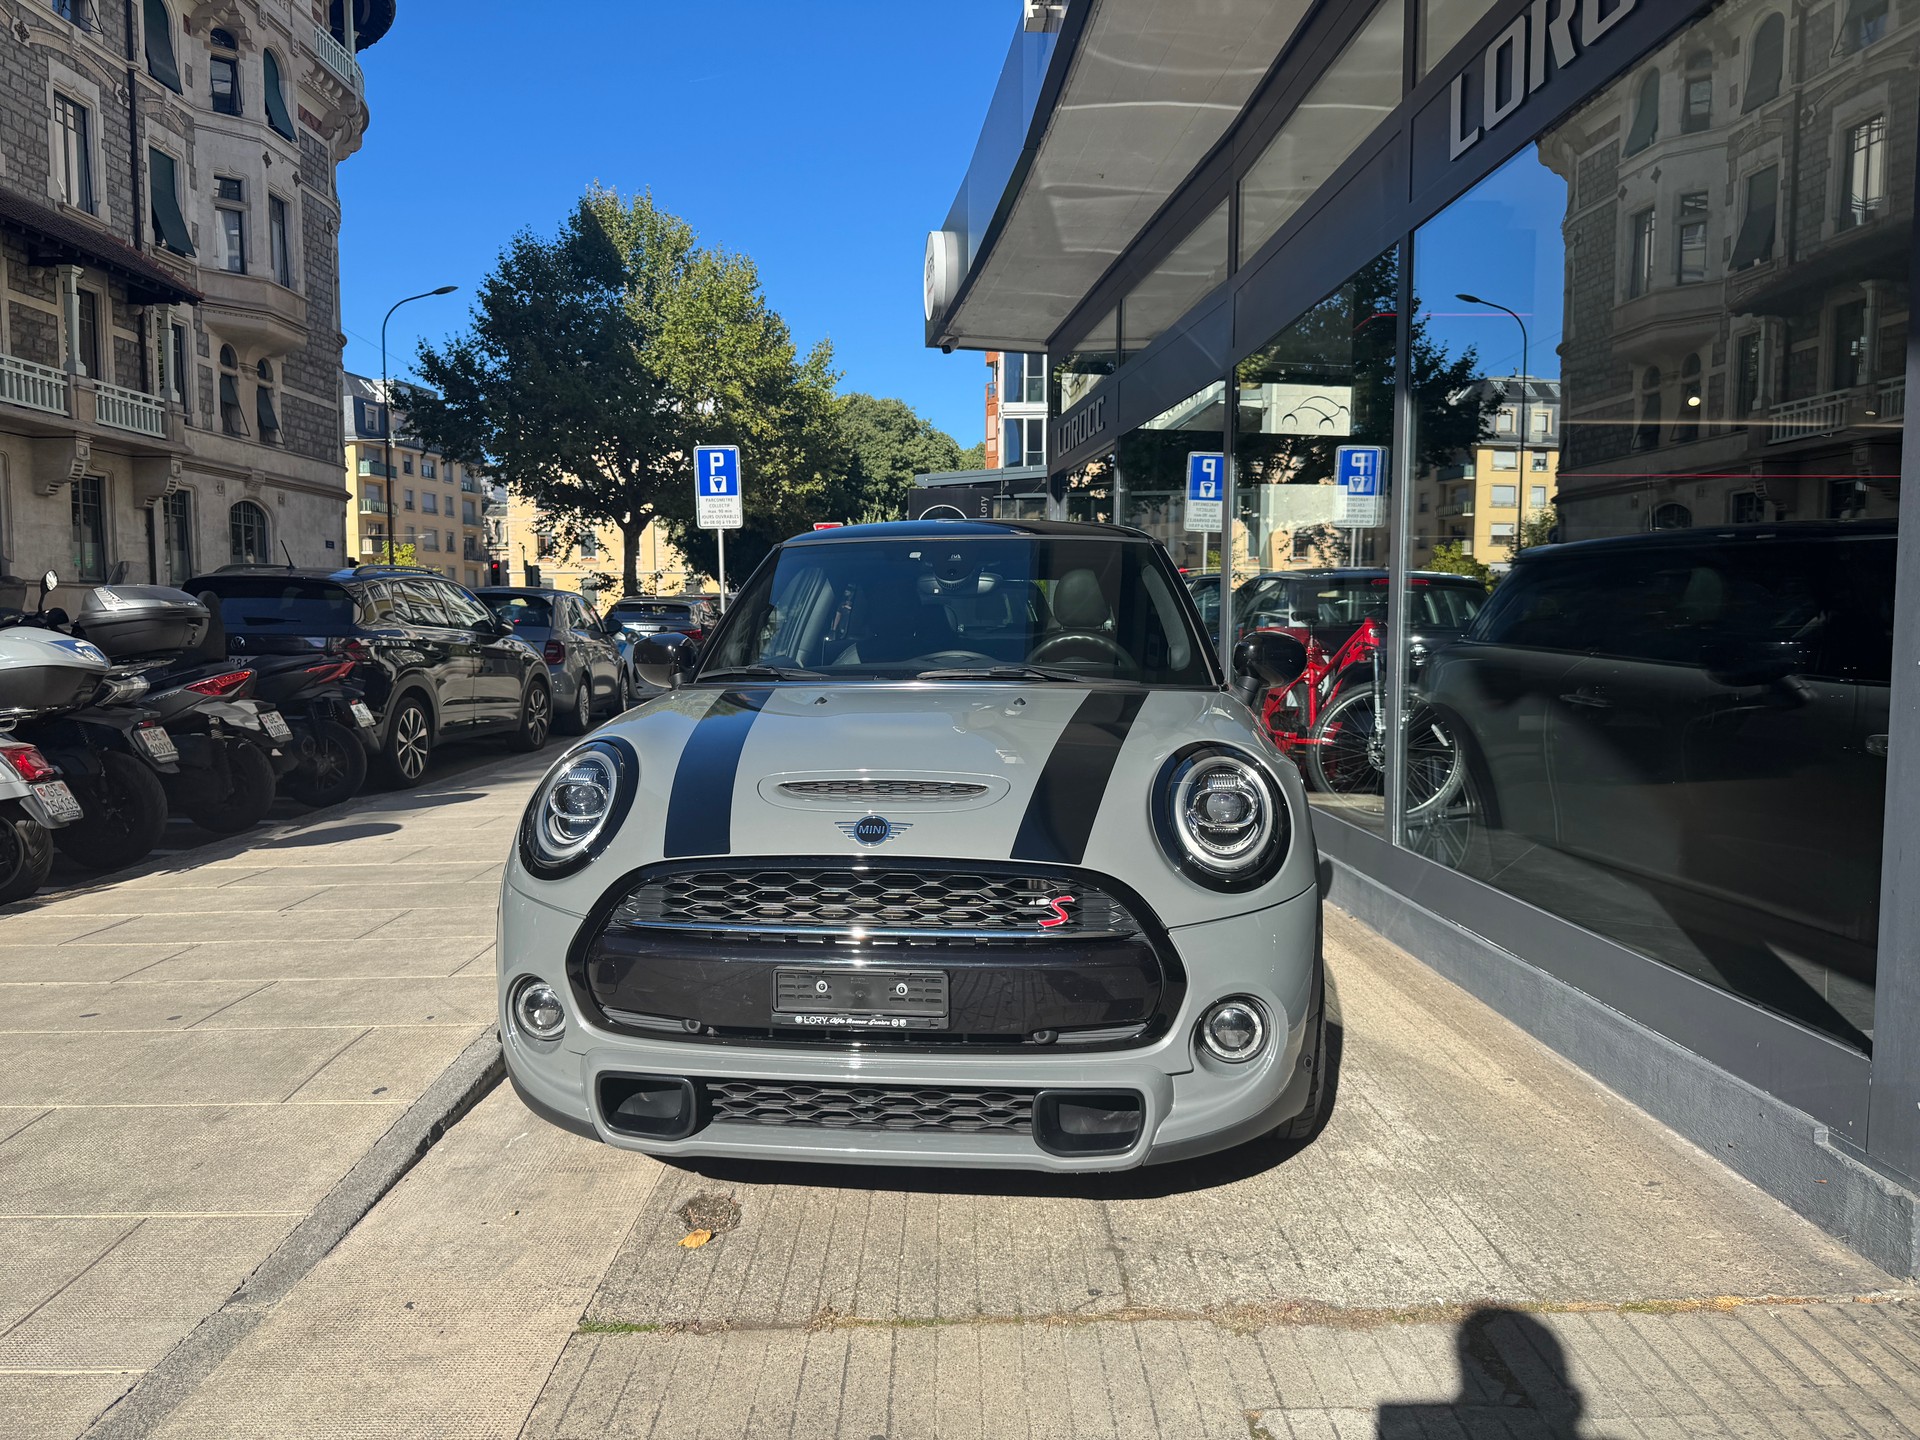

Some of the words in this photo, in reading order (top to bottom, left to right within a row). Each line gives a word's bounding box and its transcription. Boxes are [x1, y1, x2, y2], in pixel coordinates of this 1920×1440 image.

[1057, 395, 1105, 458] LOROCC
[710, 452, 724, 475] P
[980, 496, 989, 517] Lory
[266, 714, 279, 724] GE
[149, 730, 162, 741] GE
[45, 784, 62, 797] GE
[46, 797, 78, 813] 154133
[859, 825, 885, 834] MINI
[1038, 896, 1075, 927] S
